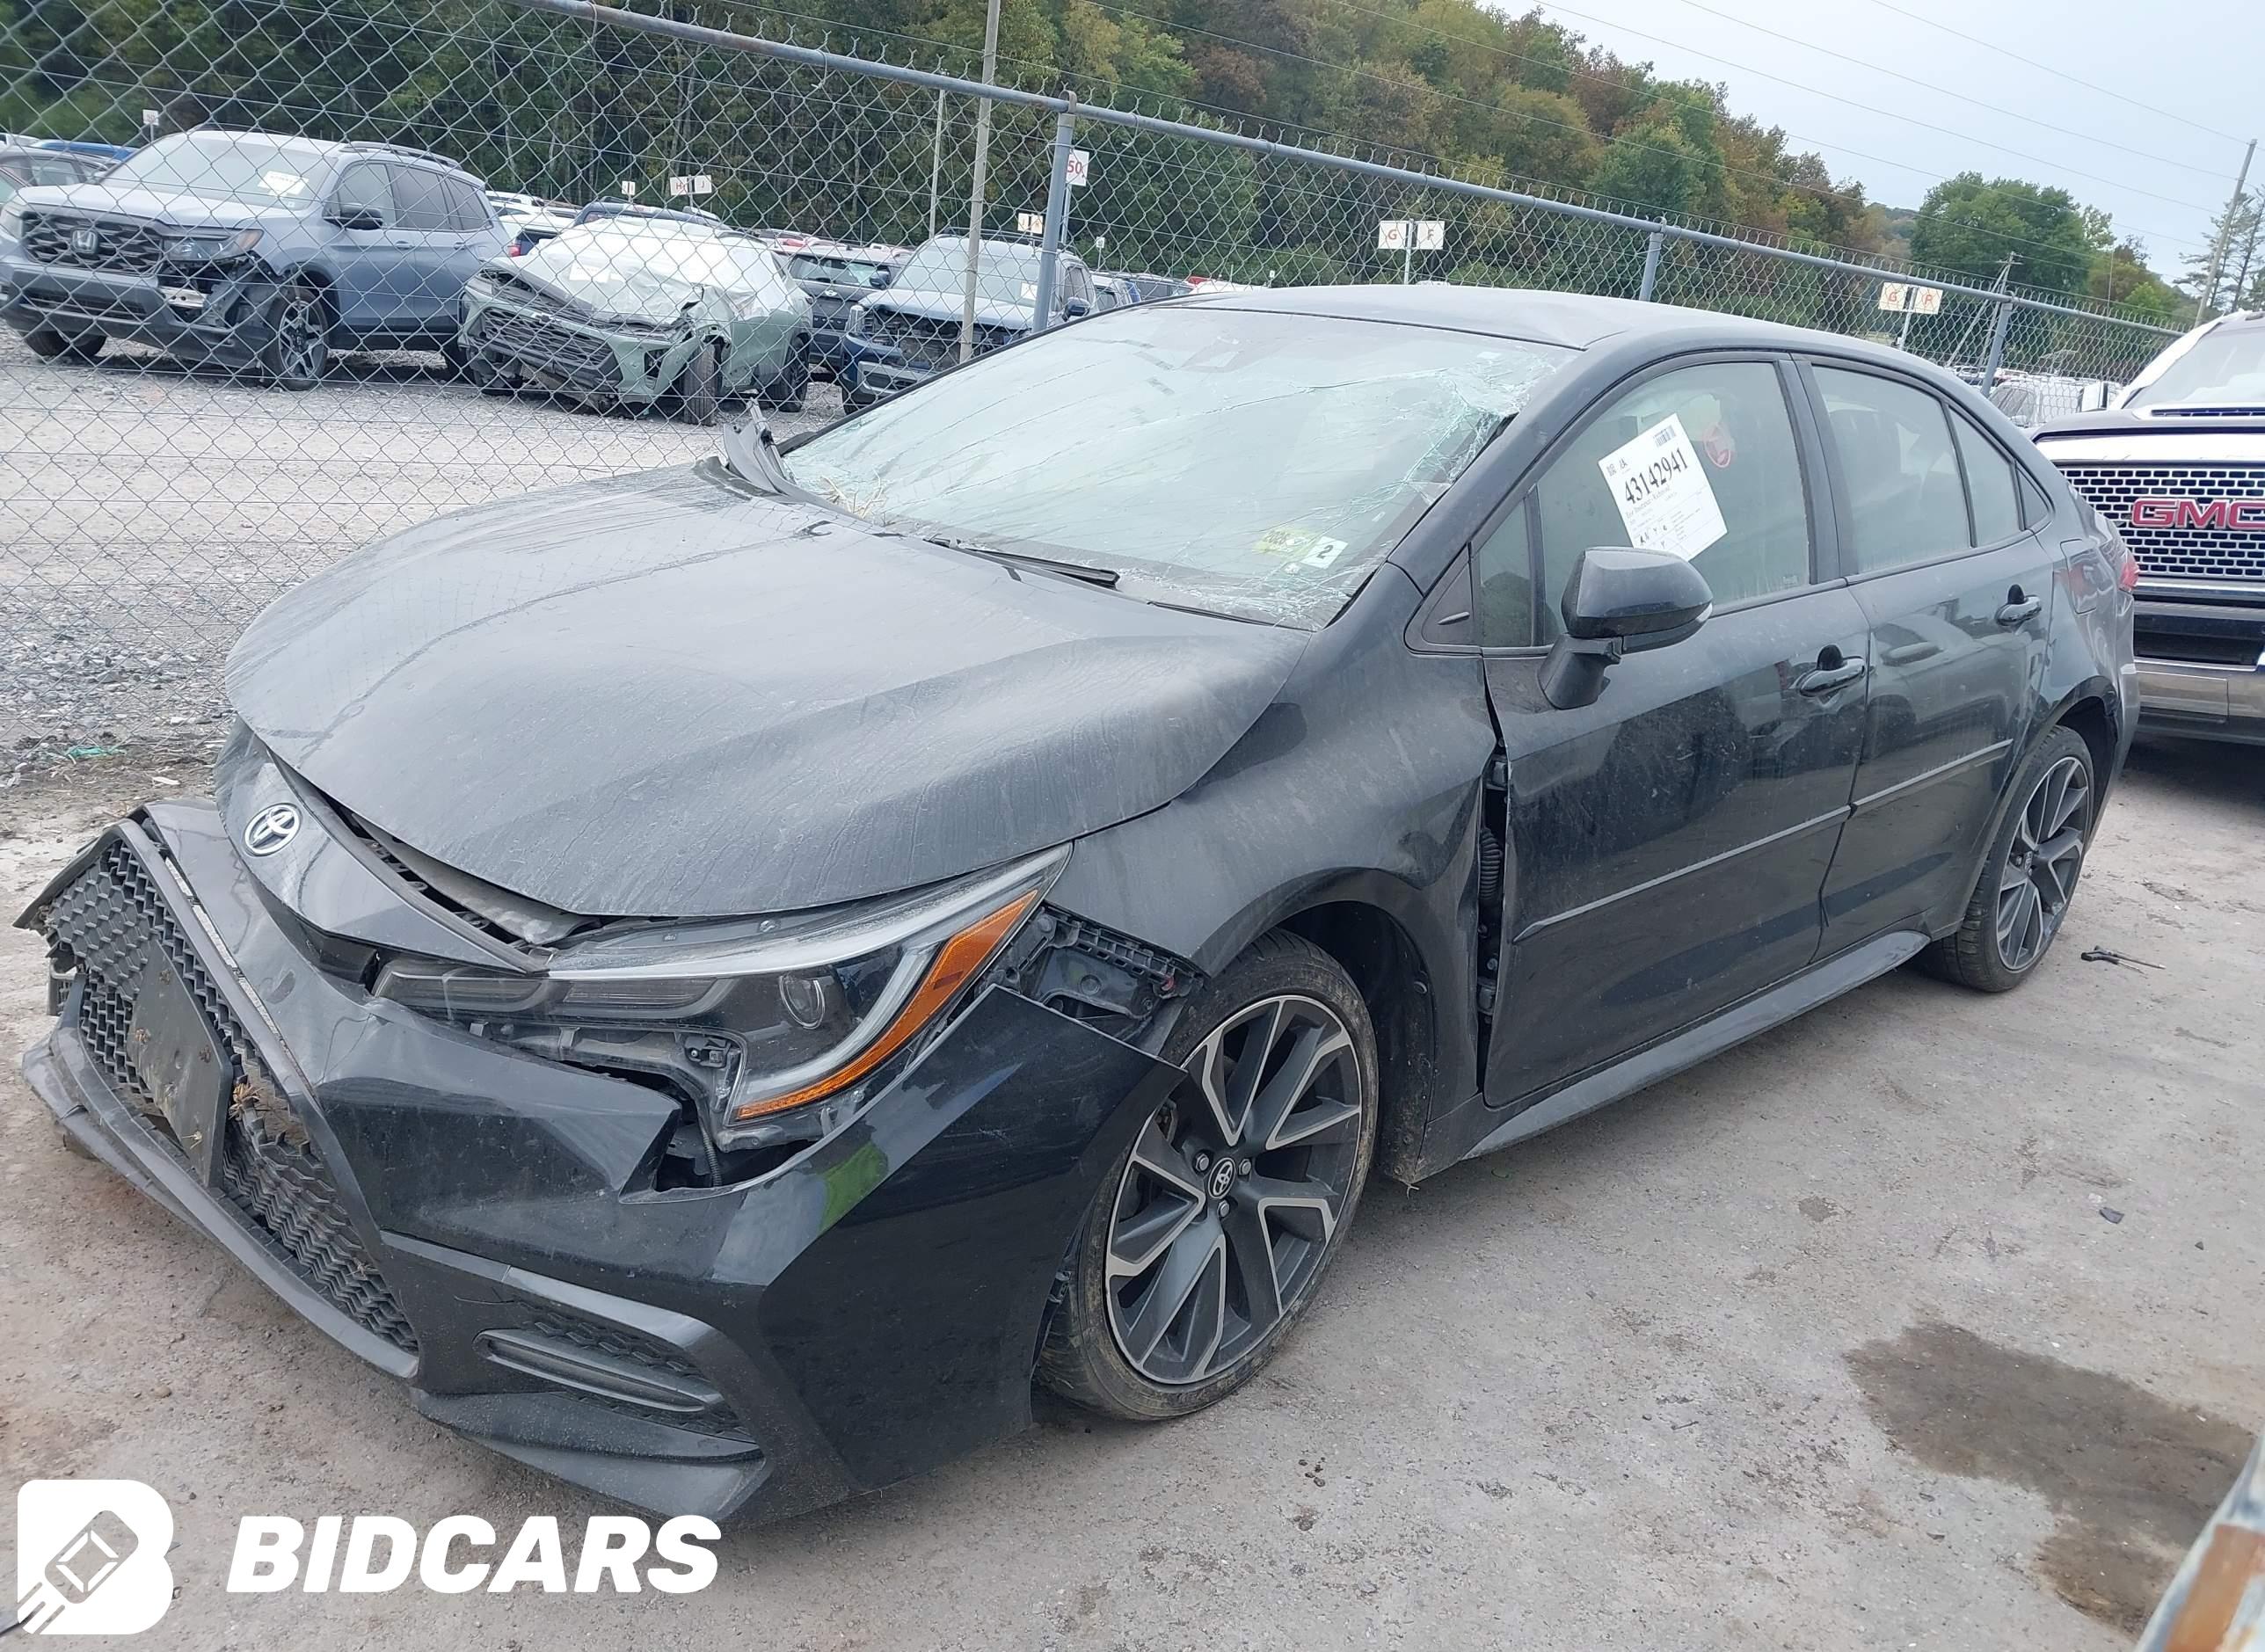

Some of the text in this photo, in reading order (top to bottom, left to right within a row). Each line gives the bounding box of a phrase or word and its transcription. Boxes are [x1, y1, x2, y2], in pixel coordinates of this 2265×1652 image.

[1067, 160, 1082, 174] 50
[1387, 229, 1398, 240] G
[1625, 447, 1687, 505] 43142941
[2131, 498, 2265, 530] GMC
[1315, 544, 1334, 559] 2
